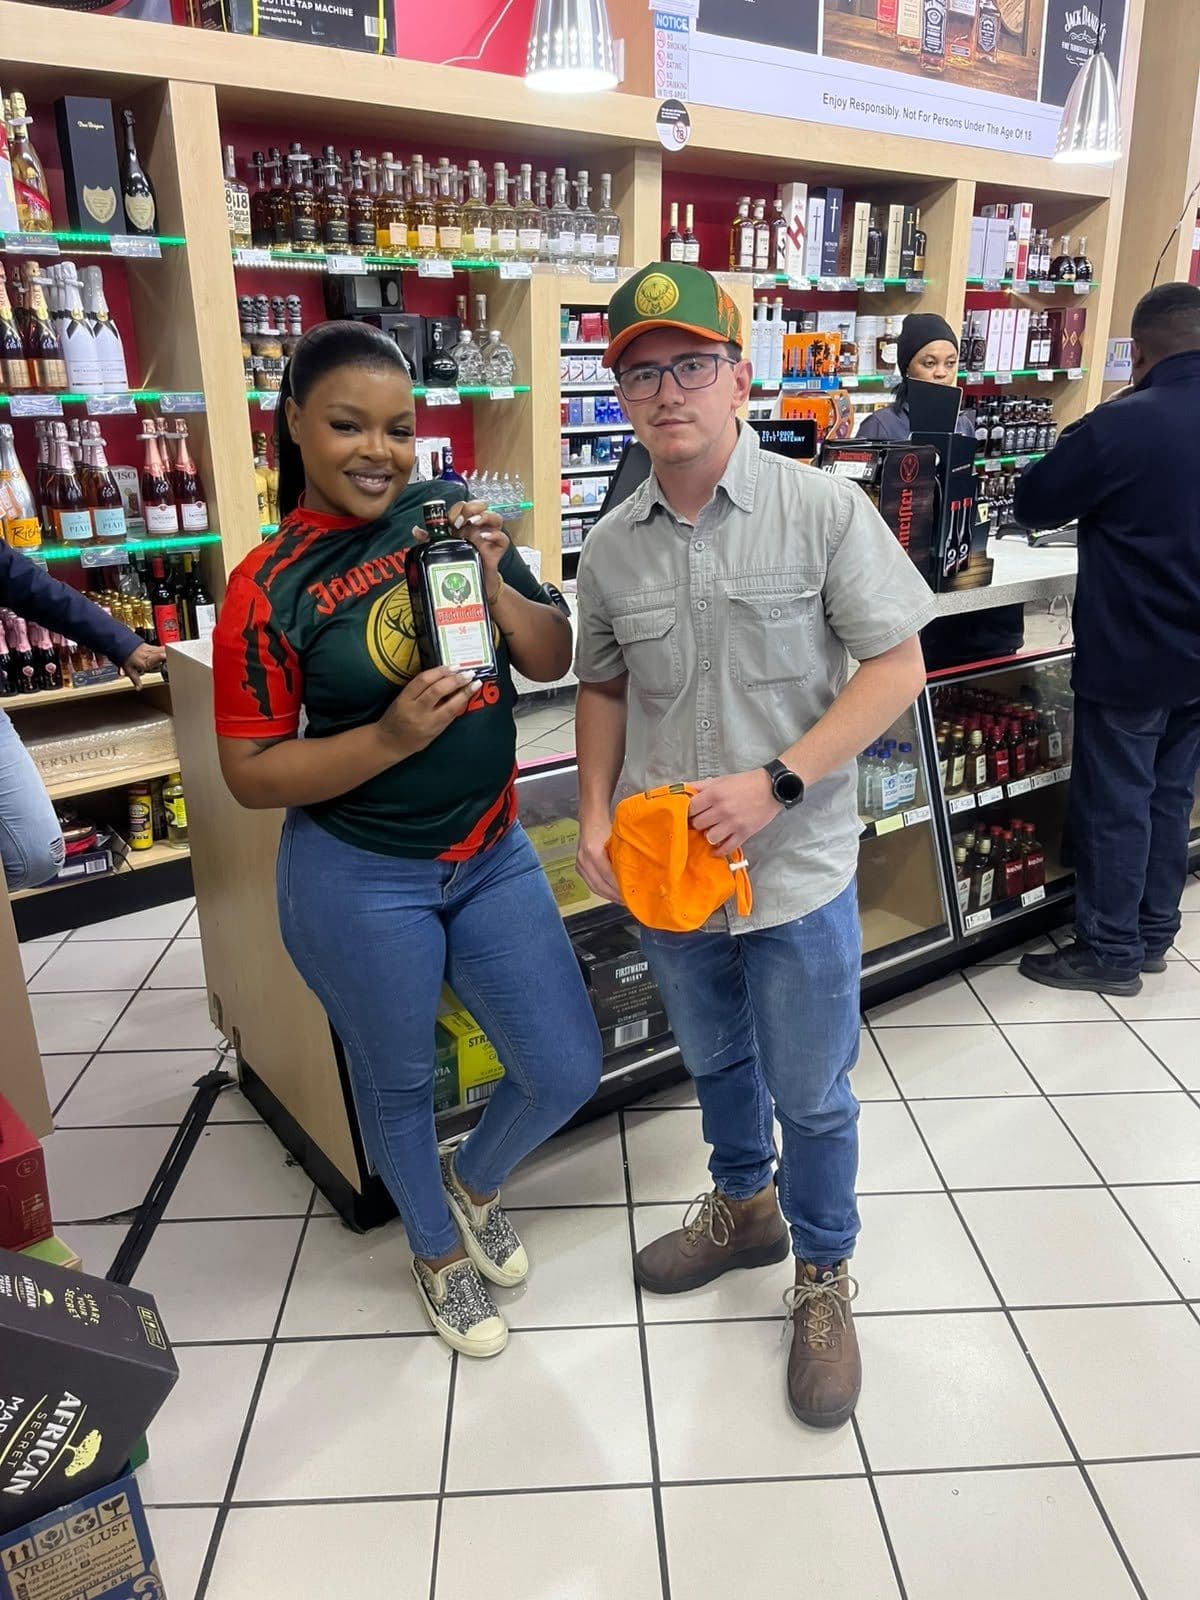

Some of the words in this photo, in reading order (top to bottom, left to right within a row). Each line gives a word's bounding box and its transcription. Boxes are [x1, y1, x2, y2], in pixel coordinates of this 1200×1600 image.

[314, 3, 354, 17] MACHINE
[1064, 9, 1082, 33] JACK
[656, 13, 689, 32] NOTICE
[666, 41, 688, 52] SMOKING
[666, 61, 683, 71] EATING
[822, 92, 848, 111] Enjoy
[902, 107, 917, 121] Not
[918, 110, 931, 123] For
[932, 112, 963, 129] Persons
[963, 119, 986, 132] Under
[986, 122, 1000, 136] The
[1000, 126, 1014, 140] Age
[1014, 128, 1024, 140] Of
[1024, 130, 1033, 141] 18
[761, 435, 777, 443] CITY
[779, 435, 806, 443] GATEWAY
[615, 960, 649, 979] FIRSTWATCH
[21, 1275, 37, 1309] AFRICAN
[64, 1288, 81, 1320] SECRET
[76, 1296, 88, 1317] YOUR
[83, 1293, 101, 1325] SHARE
[2, 1391, 82, 1495] AFRICAN
[7, 1411, 48, 1468] SECRET
